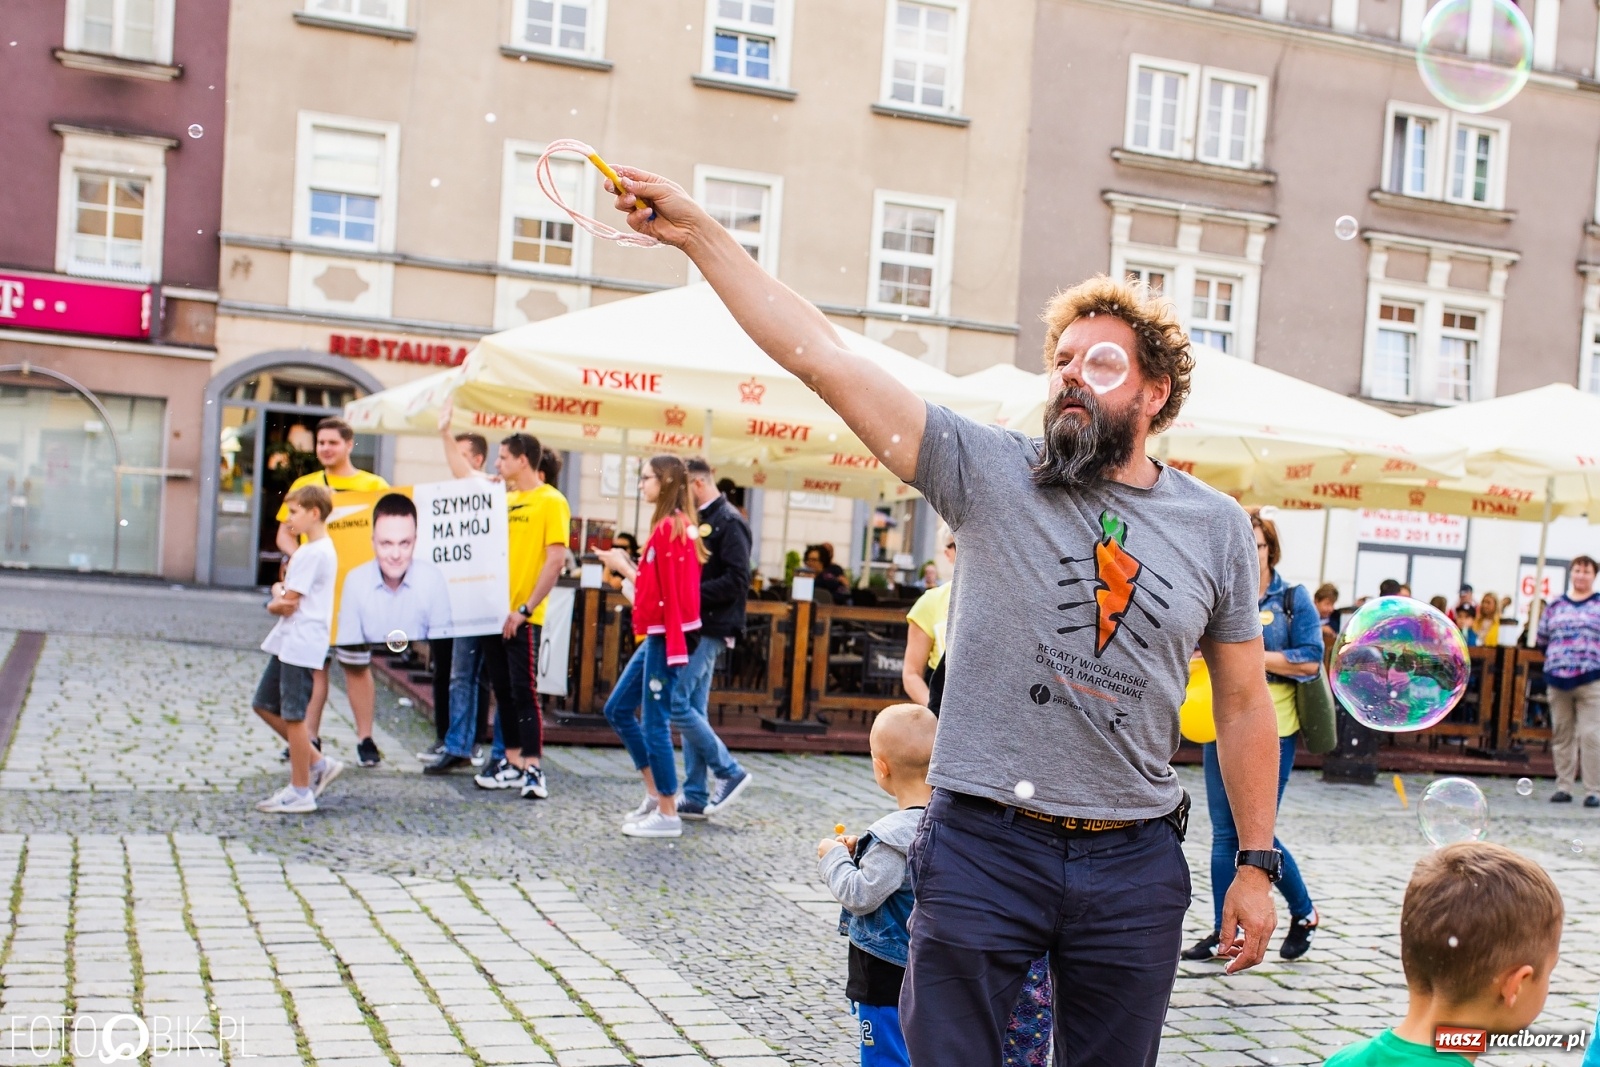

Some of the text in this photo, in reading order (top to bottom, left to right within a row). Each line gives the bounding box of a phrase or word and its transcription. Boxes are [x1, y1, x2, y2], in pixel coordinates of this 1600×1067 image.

[580, 367, 663, 394] TYSKIE
[433, 494, 493, 516] SZYMON
[433, 512, 491, 540] MA MÓJ
[433, 544, 472, 563] GŁOS
[1036, 655, 1044, 664] O
[1077, 671, 1144, 700] MARCHEWKĘ
[1037, 642, 1079, 665] REGATY
[1079, 657, 1150, 689] WIOŚLARSKIE
